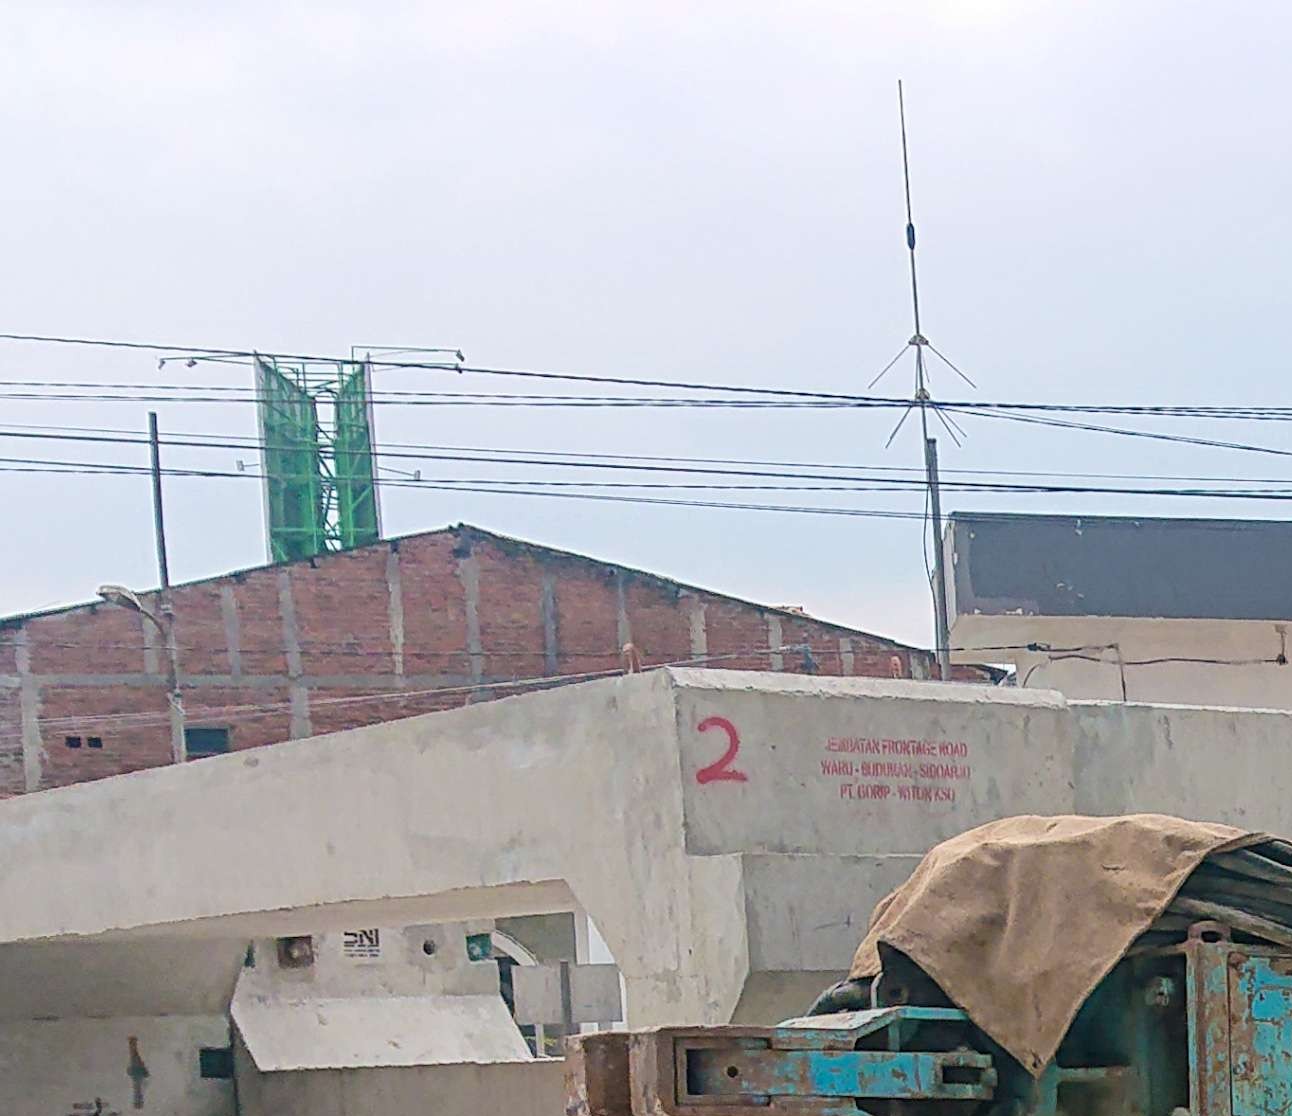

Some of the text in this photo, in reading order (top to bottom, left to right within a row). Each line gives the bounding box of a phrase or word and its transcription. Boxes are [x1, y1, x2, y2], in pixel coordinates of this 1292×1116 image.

[696, 716, 748, 785] 2
[938, 742, 968, 758] ROAD
[821, 760, 853, 776] WARU
